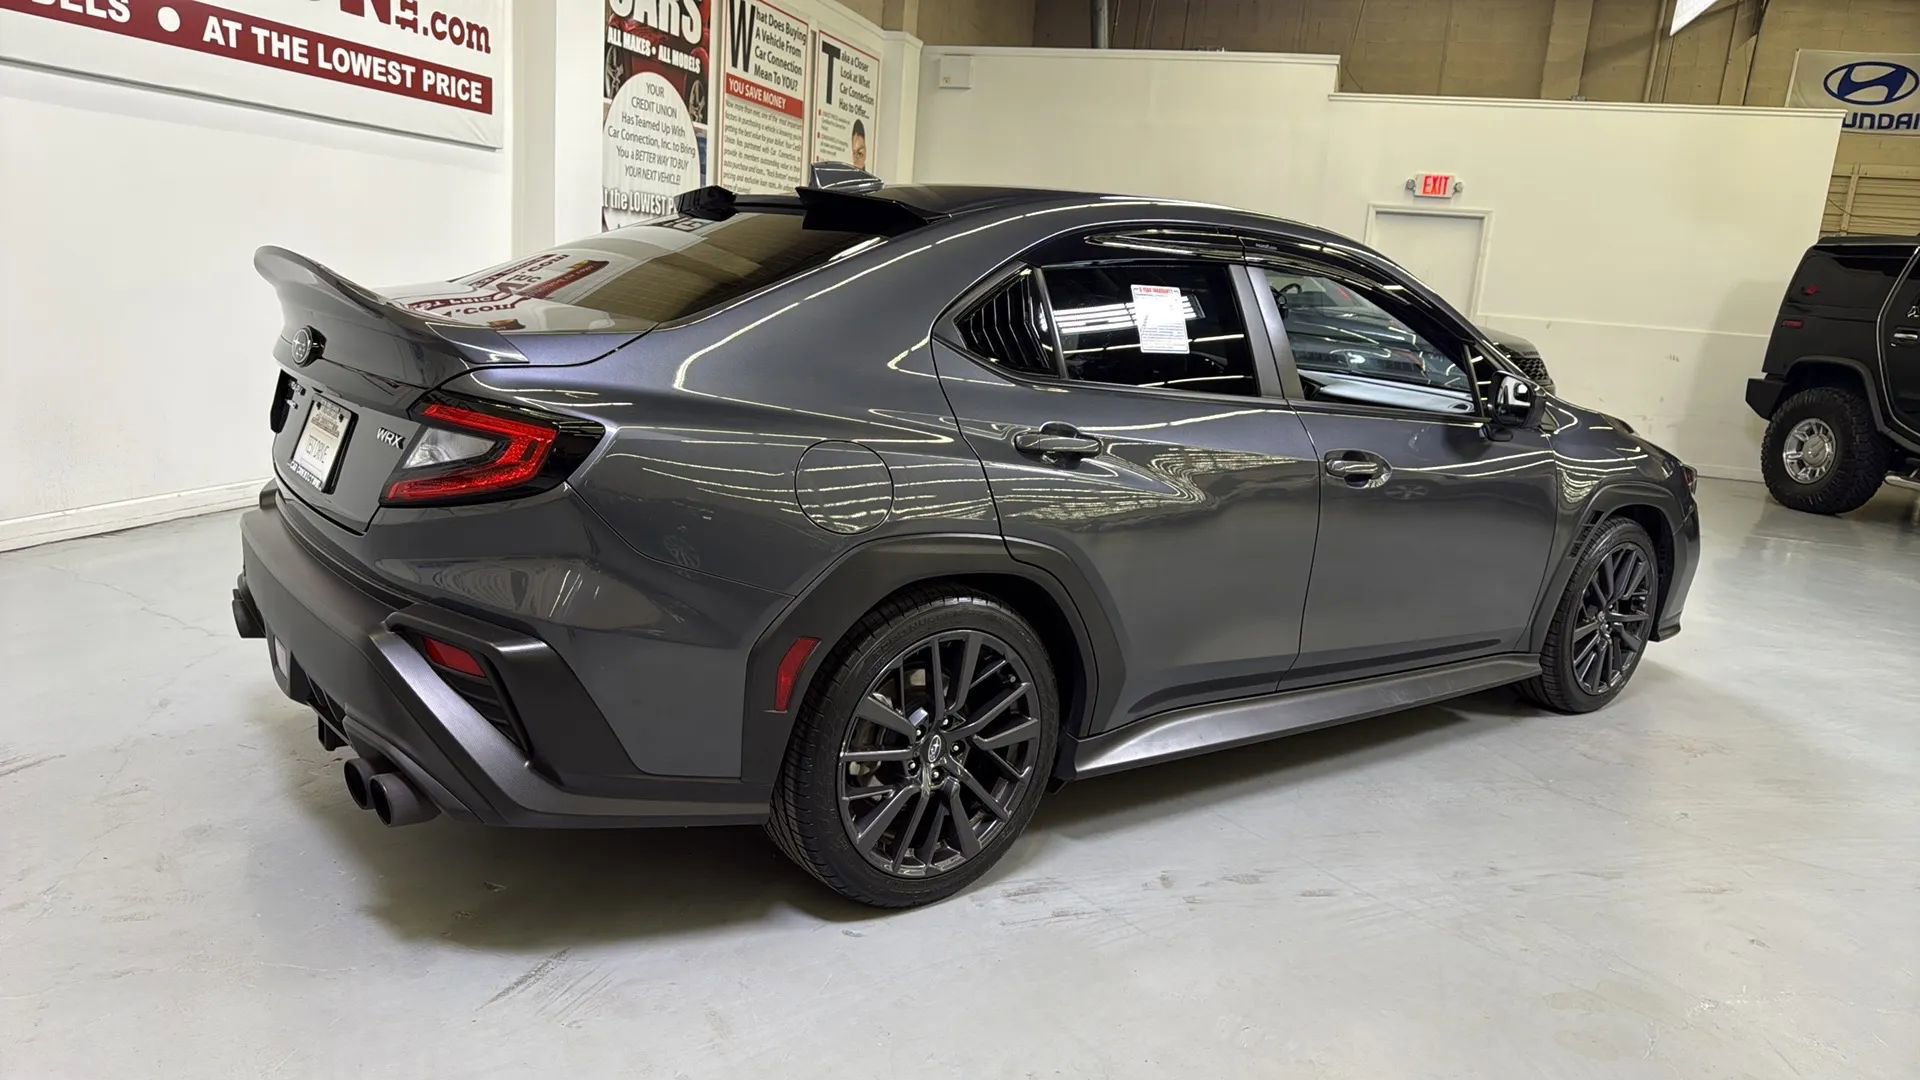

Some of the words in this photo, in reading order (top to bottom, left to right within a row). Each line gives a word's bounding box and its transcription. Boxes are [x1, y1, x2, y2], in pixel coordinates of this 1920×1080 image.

[755, 26, 761, 41] A
[762, 28, 785, 51] Vehicle
[785, 41, 802, 58] From
[768, 14, 785, 32] Does
[785, 22, 807, 46] Buying
[202, 15, 243, 49] AT
[250, 26, 309, 65] THE
[317, 42, 416, 89] LOWEST
[422, 68, 483, 105] PRICE
[607, 26, 622, 47] ALL
[623, 31, 651, 57] MAKES
[658, 44, 671, 64] ALL
[672, 49, 701, 74] MODELS
[754, 46, 767, 61] Car
[767, 50, 802, 76] Connection
[754, 63, 773, 82] Mean
[773, 71, 781, 85] To
[781, 74, 799, 92] YOU?
[840, 65, 852, 82] Look
[852, 73, 858, 83] at
[858, 74, 871, 89] What
[854, 56, 869, 73] Closer
[646, 82, 665, 98] YOUR
[728, 77, 745, 96] YOU
[745, 84, 763, 102] SAVE
[762, 90, 787, 110] MONEY
[840, 82, 848, 95] Car
[848, 86, 874, 106] Connection
[631, 96, 655, 113] CREDIT
[656, 102, 677, 119] UNION
[839, 97, 848, 112] Has
[848, 103, 854, 114] to
[622, 112, 634, 125] Has
[635, 115, 660, 133] Teamed
[661, 123, 671, 136] Up
[671, 125, 685, 138] With
[607, 125, 620, 138] Car
[620, 129, 660, 149] Connection,
[661, 138, 672, 151] Inc.
[672, 142, 679, 152] to
[680, 143, 696, 159] Bring
[616, 145, 629, 158] You
[635, 149, 656, 163] BETTER
[657, 154, 670, 166] WAY
[670, 156, 678, 168] TO
[678, 158, 689, 172] BUY
[624, 164, 642, 178] YOUR
[642, 167, 658, 181] NEXT
[1423, 175, 1449, 195] EXIT
[610, 187, 628, 211] the
[629, 191, 666, 216] LOWEST
[376, 427, 404, 449] WRX
